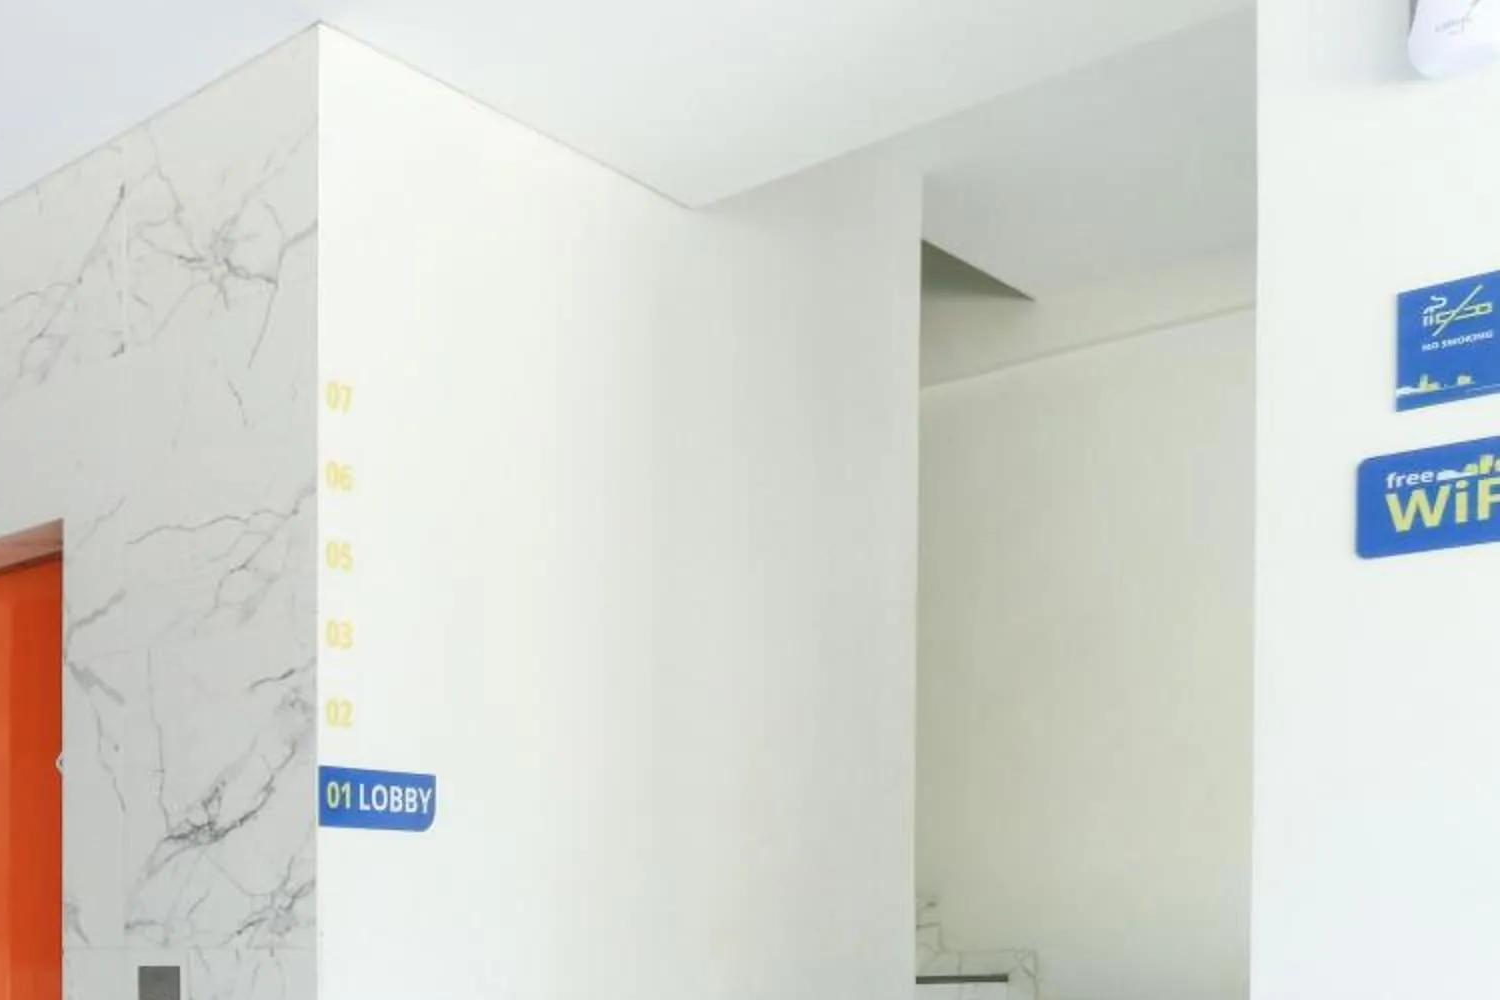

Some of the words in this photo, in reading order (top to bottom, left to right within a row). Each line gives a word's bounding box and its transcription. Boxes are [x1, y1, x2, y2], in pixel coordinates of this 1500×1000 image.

[1441, 329, 1494, 350] SMOKING
[326, 381, 352, 414] 07
[326, 461, 352, 493] 06
[1385, 471, 1435, 489] free
[326, 540, 353, 572] 05
[326, 620, 353, 650] 03
[326, 698, 352, 729] 02
[326, 781, 352, 810] 01
[358, 782, 432, 815] LOBBY
